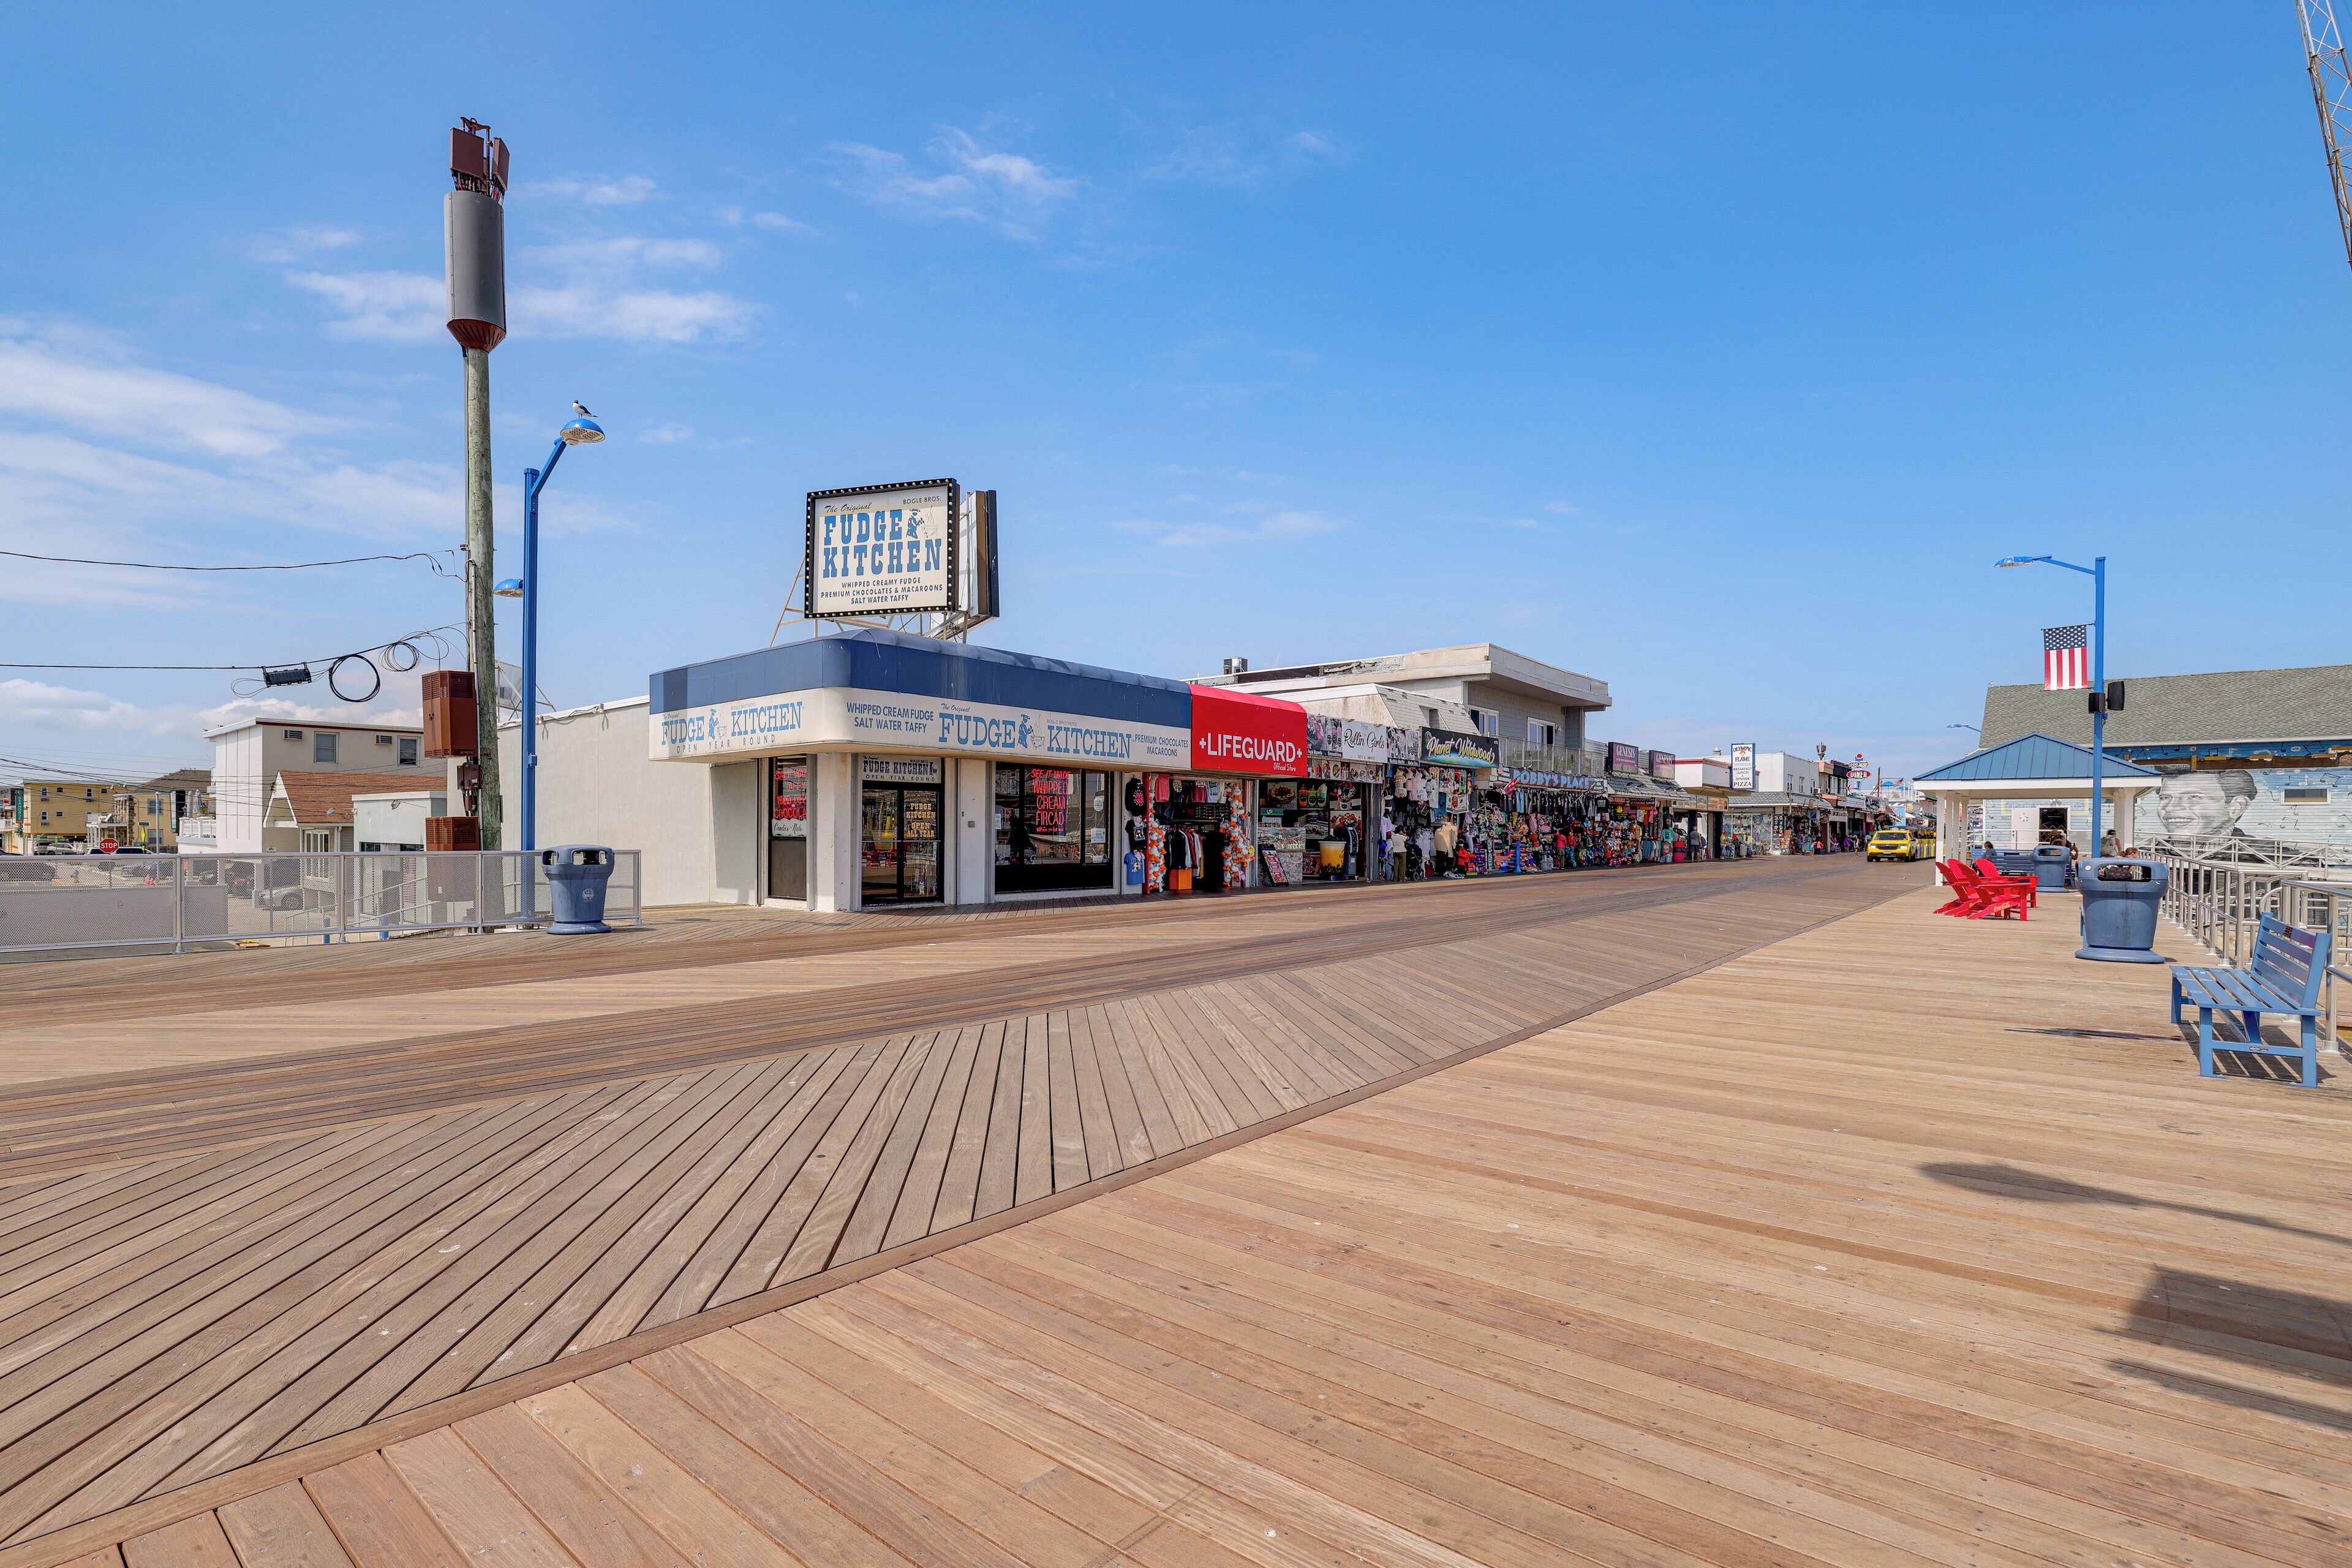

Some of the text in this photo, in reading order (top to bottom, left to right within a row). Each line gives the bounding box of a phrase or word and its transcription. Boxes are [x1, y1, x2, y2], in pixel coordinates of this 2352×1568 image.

[840, 502, 872, 512] Original
[824, 509, 902, 546] FUDGE
[823, 538, 941, 578] KITCHEN
[852, 587, 892, 596] CHOCOLATES
[901, 584, 943, 593] MACAROONS
[846, 703, 934, 721] WHIPPED CREAM FUDGE
[951, 704, 970, 713] Original
[662, 716, 704, 745] FUDGE
[731, 701, 802, 736] KITCHEN
[854, 717, 927, 733] SALT WATER TAFFY
[939, 712, 1016, 748] FUDGE
[676, 734, 775, 753] OPEN YEAR ROUND
[1047, 725, 1132, 758] KITCHEN
[1134, 734, 1188, 748] PREMIUM CHOCOLATES
[1208, 733, 1296, 763] LIFEGUARD
[1366, 731, 1385, 753] Girls
[1147, 747, 1178, 757] MACAROONS
[1427, 736, 1495, 764] Planet Wildwood
[1616, 745, 1635, 758] GENESIS
[1656, 753, 1673, 765] GENESIS
[863, 761, 928, 775] FUDGE KITCHEN
[1031, 769, 1044, 778] SEE
[1273, 763, 1297, 772] Official Store
[1033, 780, 1069, 794] WHIPPED
[1513, 769, 1559, 787] BOBBY'S
[1559, 776, 1589, 790] PLACE
[1036, 796, 1066, 810] CREAM
